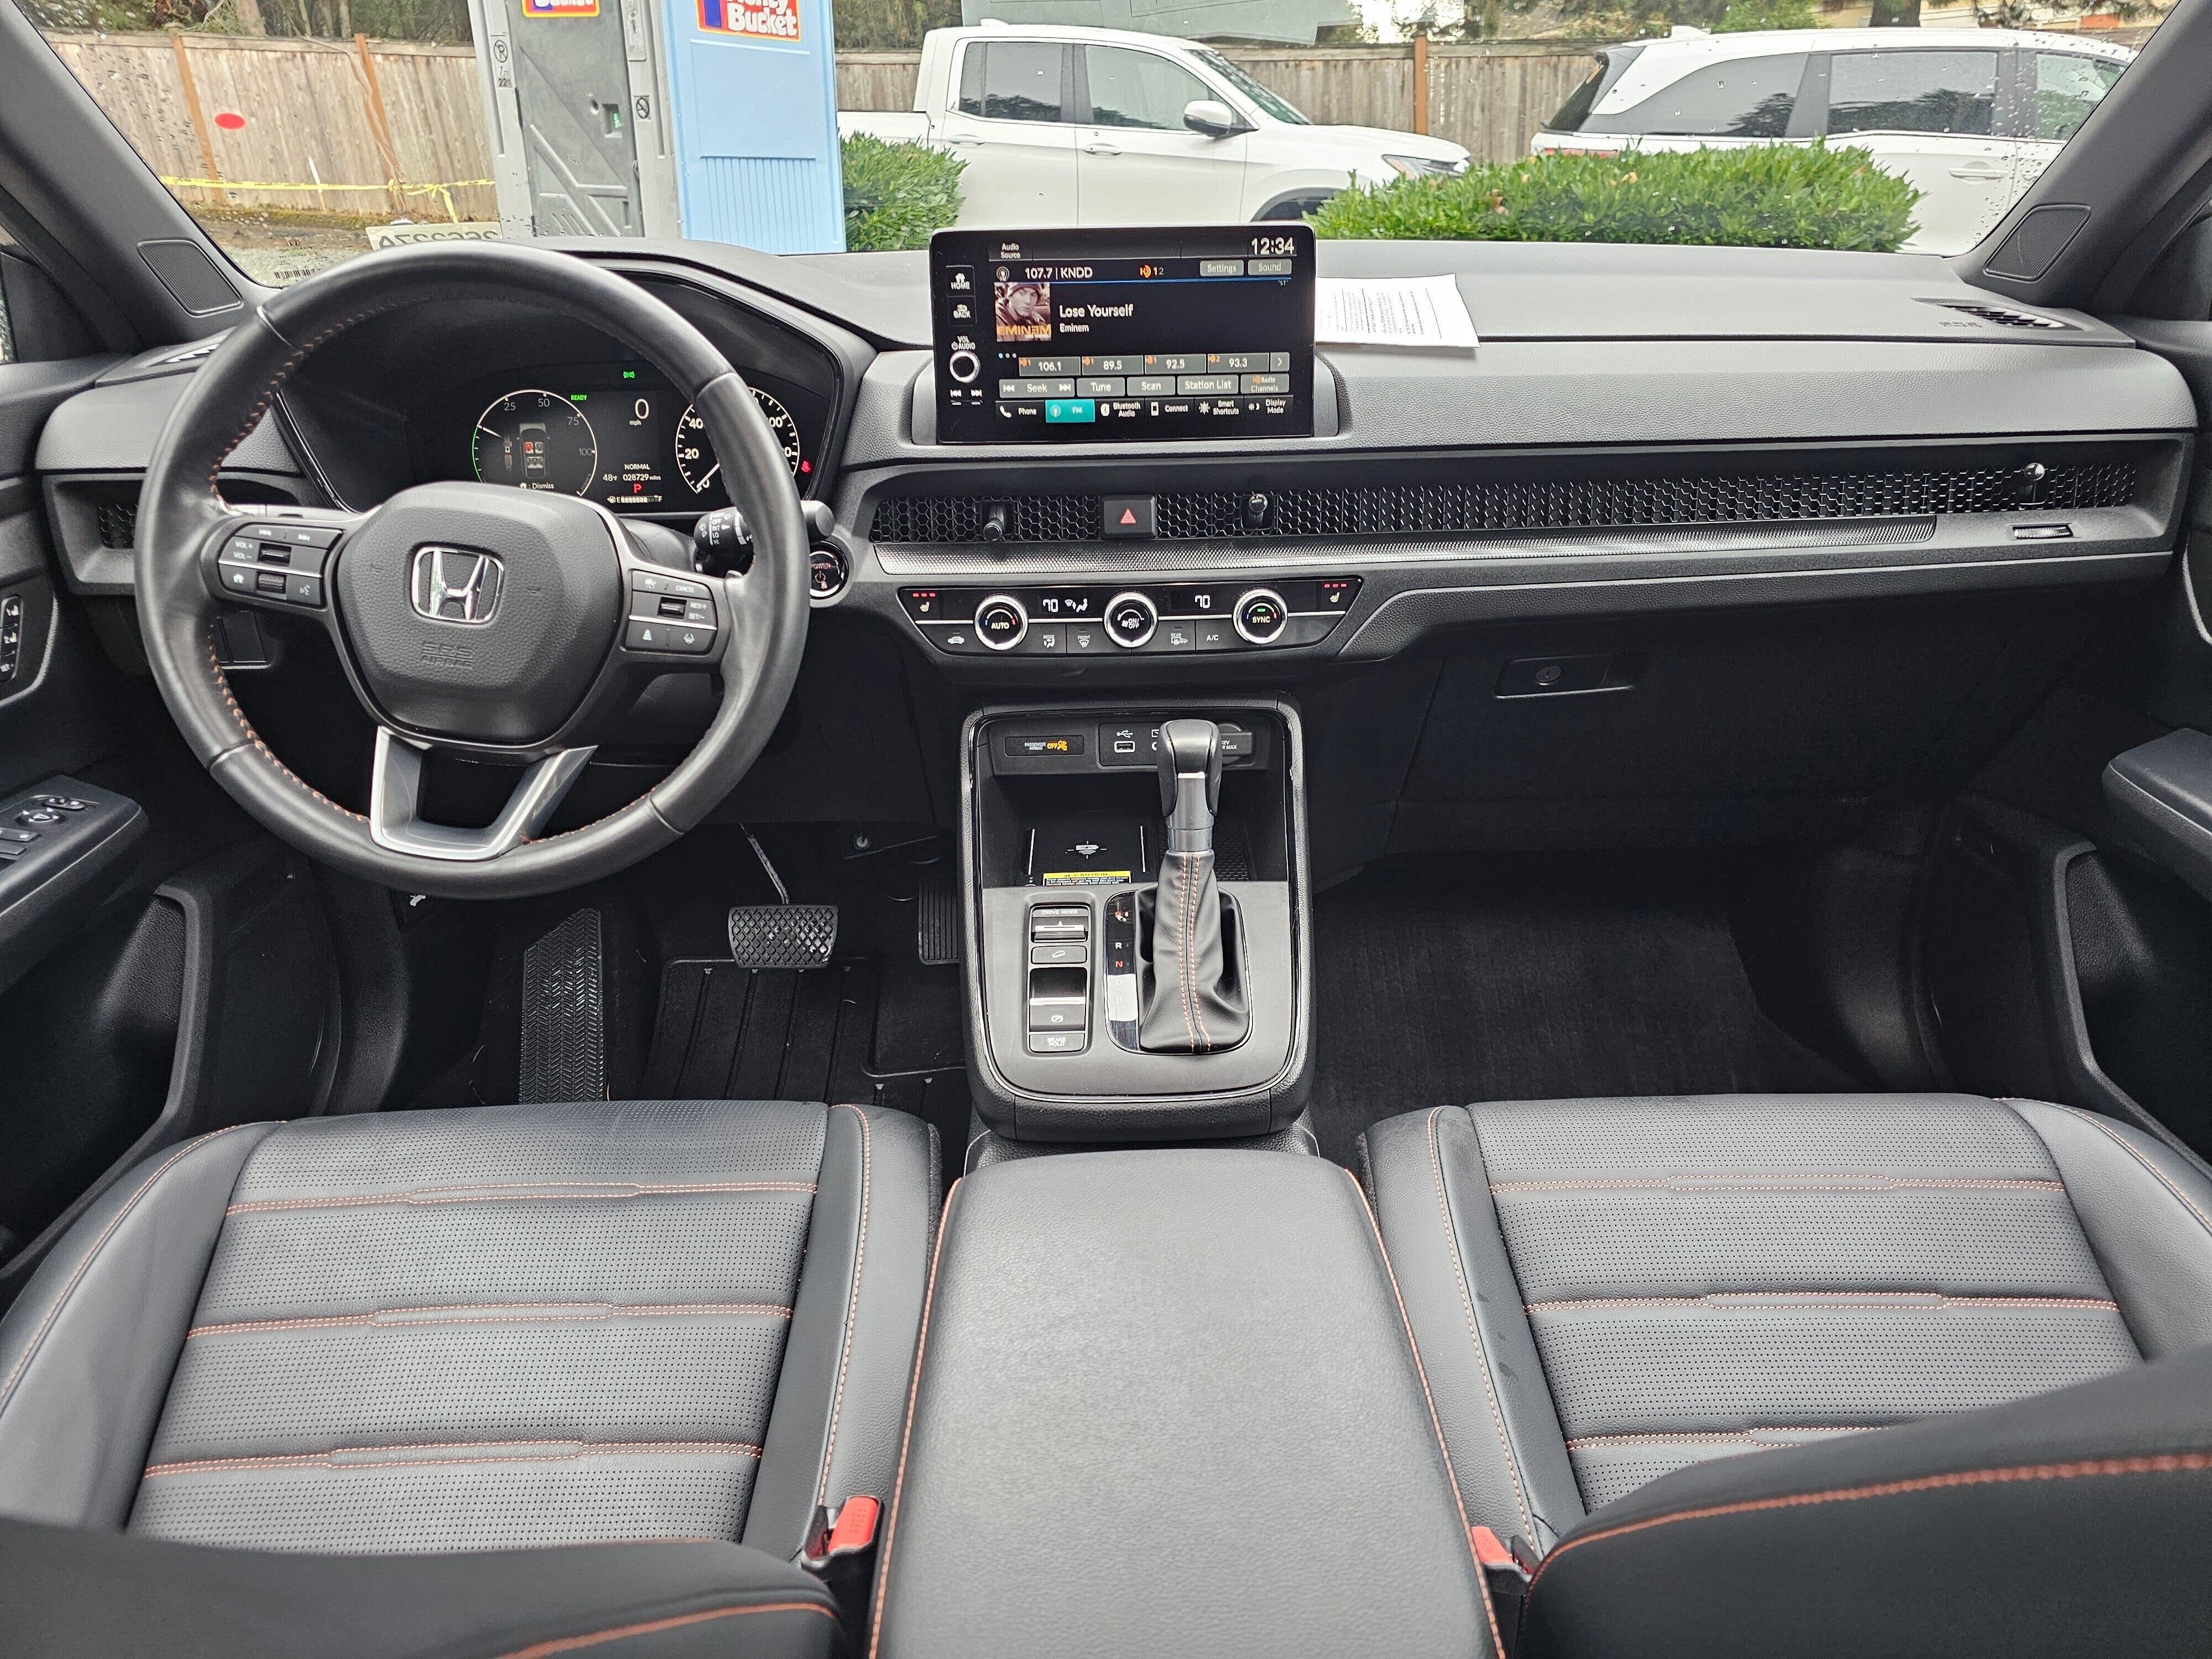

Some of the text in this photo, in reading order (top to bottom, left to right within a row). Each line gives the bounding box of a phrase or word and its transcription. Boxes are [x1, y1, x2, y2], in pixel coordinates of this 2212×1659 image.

[727, 2, 798, 36] Bucket
[1251, 237, 1295, 255] 12:34
[1208, 263, 1237, 274] Settings
[1259, 263, 1281, 272] Sound
[1025, 267, 1093, 279] 107.7 KNDD
[1059, 304, 1134, 318] Lose Yourself
[1060, 323, 1089, 332] Eminem
[1038, 361, 1061, 372] 106.1
[1103, 361, 1122, 371] 89.5
[1166, 359, 1185, 369] 92.5
[1229, 358, 1248, 368] 93.3
[1027, 384, 1047, 393] Seek
[1091, 382, 1112, 392] Tune
[1141, 382, 1161, 391] Scan
[1185, 379, 1232, 390] Station List
[1251, 384, 1279, 393] Channels
[504, 402, 516, 411] 25
[538, 399, 550, 407] 50
[1266, 399, 1286, 408] Display
[635, 398, 649, 419] 0
[1165, 404, 1188, 413] Connect
[567, 417, 580, 426] 75
[689, 418, 703, 429] 40
[685, 448, 699, 460] 20
[633, 483, 641, 493] P
[1043, 599, 1058, 612] 70
[1195, 595, 1210, 608] 70
